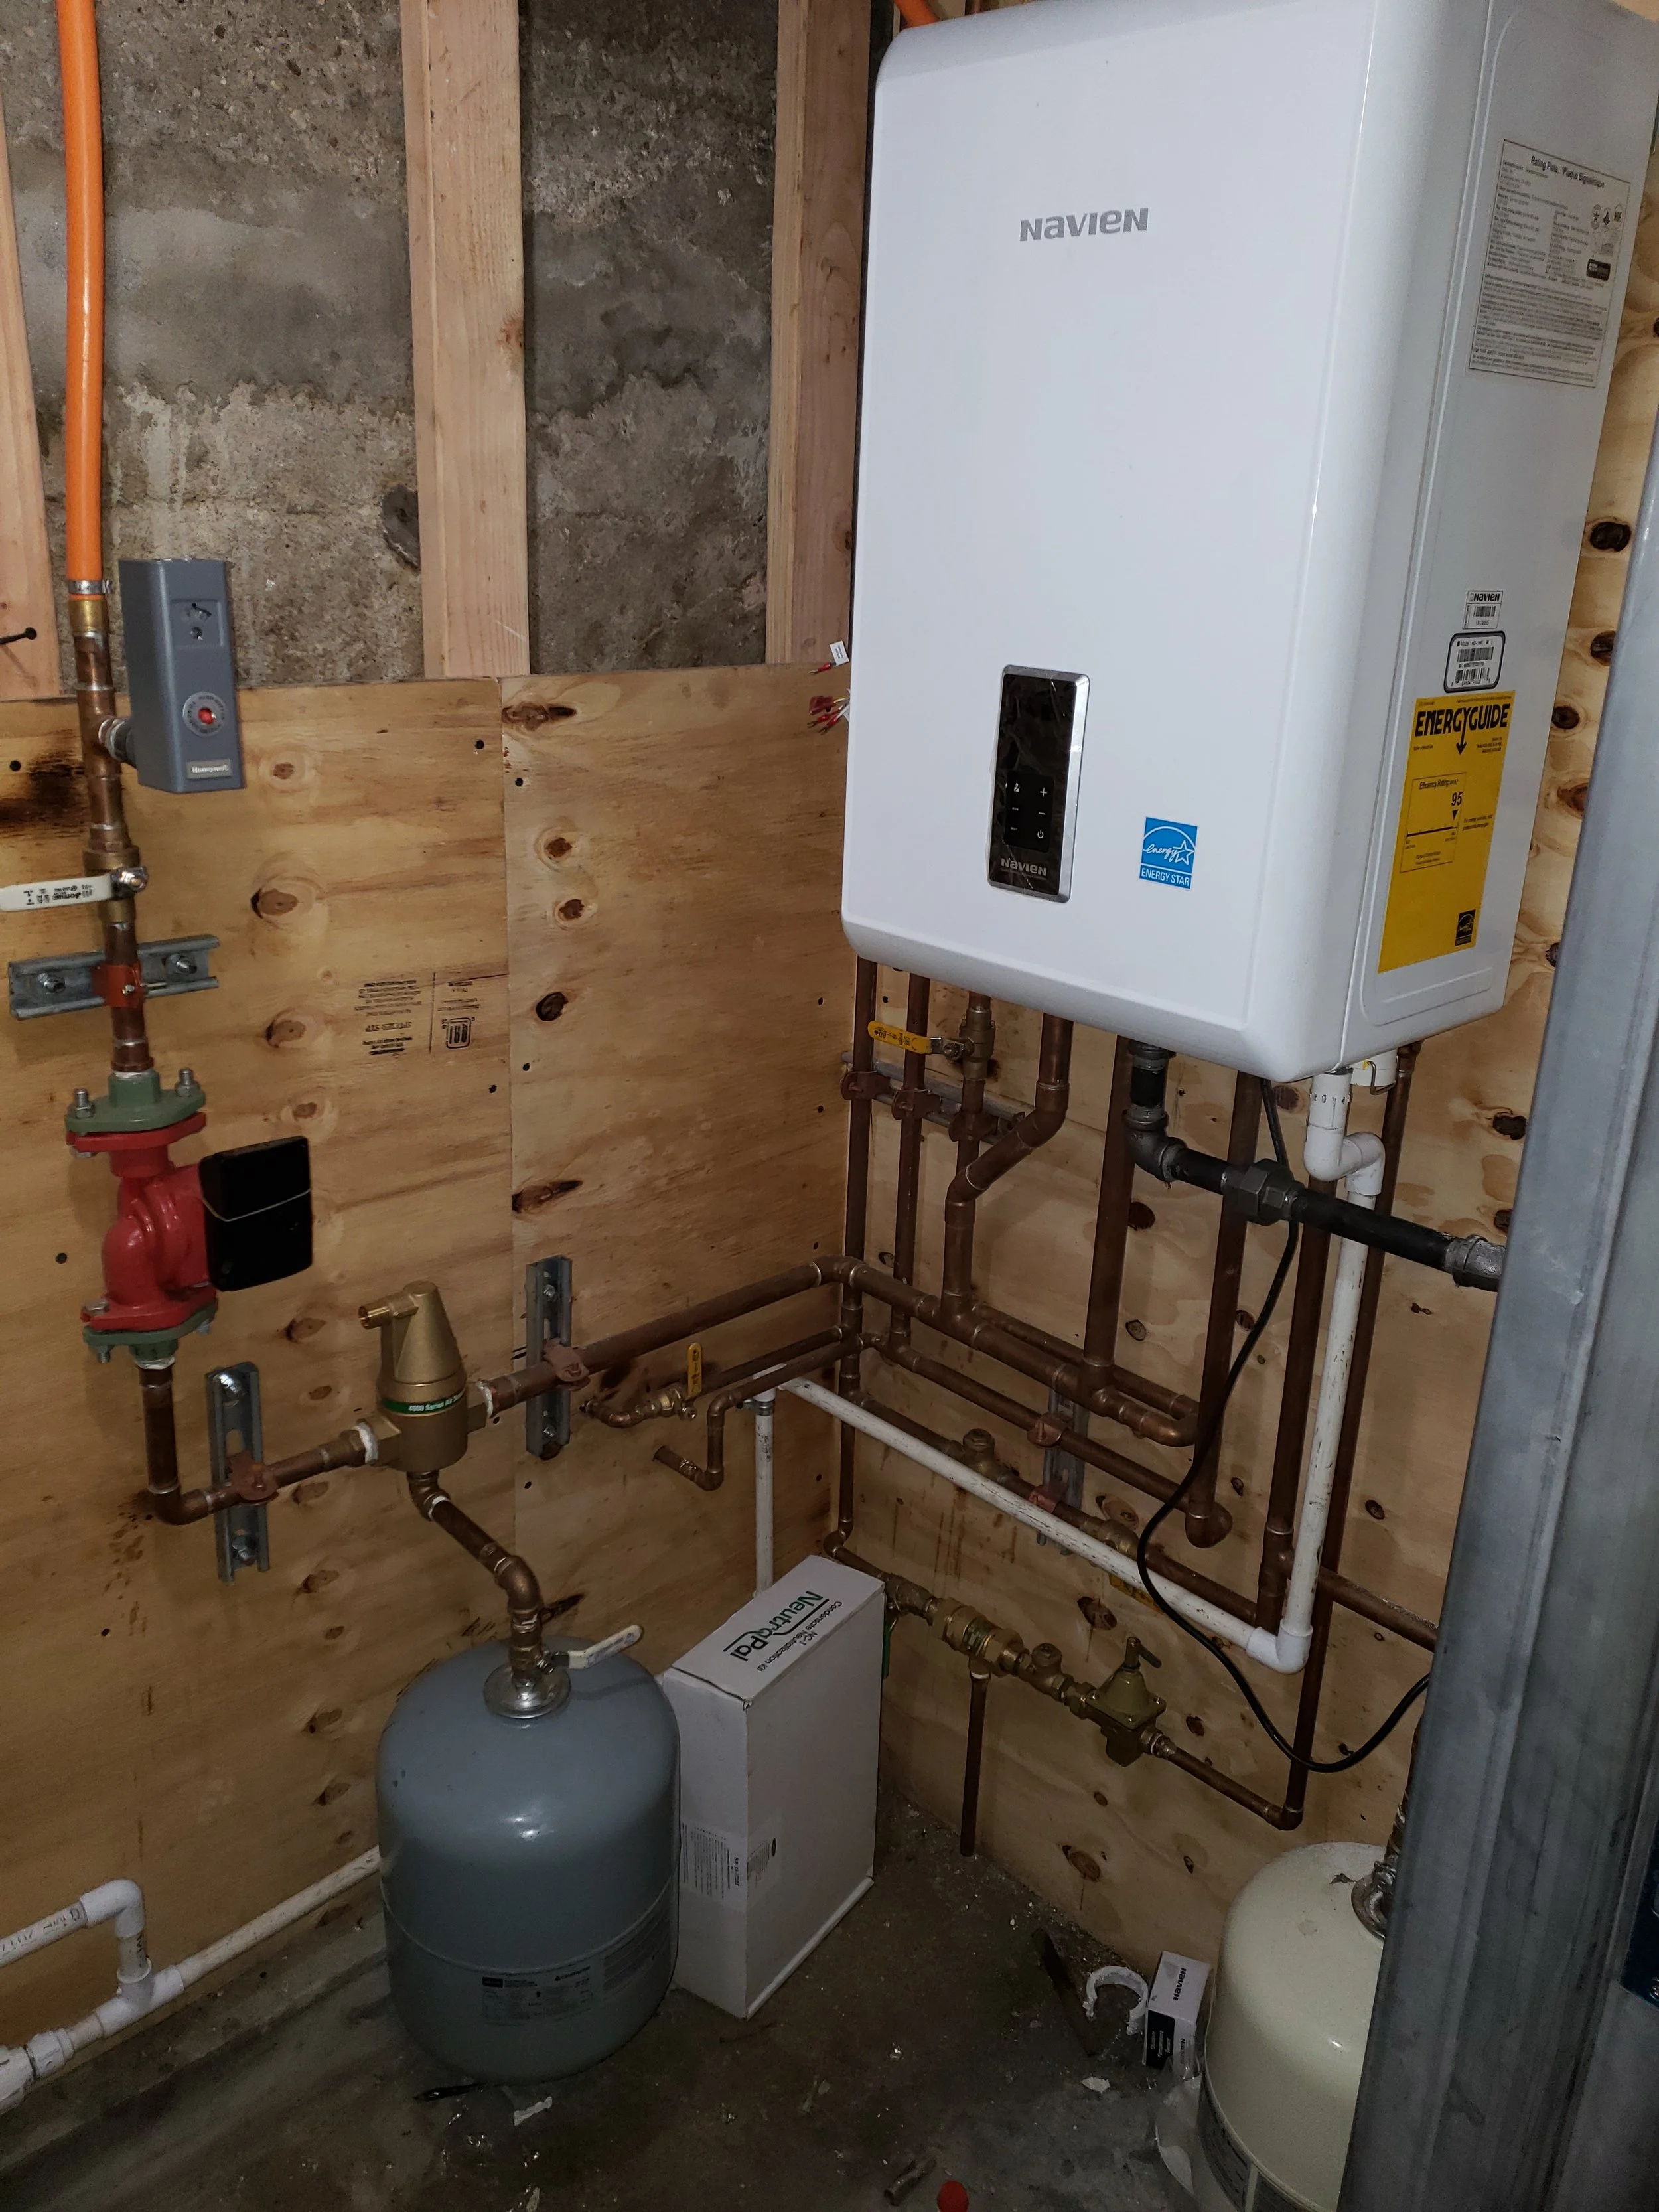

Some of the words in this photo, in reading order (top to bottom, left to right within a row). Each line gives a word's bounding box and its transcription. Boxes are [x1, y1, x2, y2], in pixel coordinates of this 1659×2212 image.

[1415, 703, 1510, 737] ENERGYGUIDE
[192, 764, 228, 773] Honeywell
[1451, 791, 1463, 806] 95
[1141, 867, 1170, 882] ENERGY
[1171, 873, 1190, 887] STAR
[425, 1402, 444, 1411] Series
[805, 1601, 843, 1631] Condensate
[729, 1590, 824, 1662] NeutraPal
[766, 1629, 810, 1665] Neutralization
[799, 1631, 818, 1646] NC-1
[756, 1663, 768, 1672] Kit
